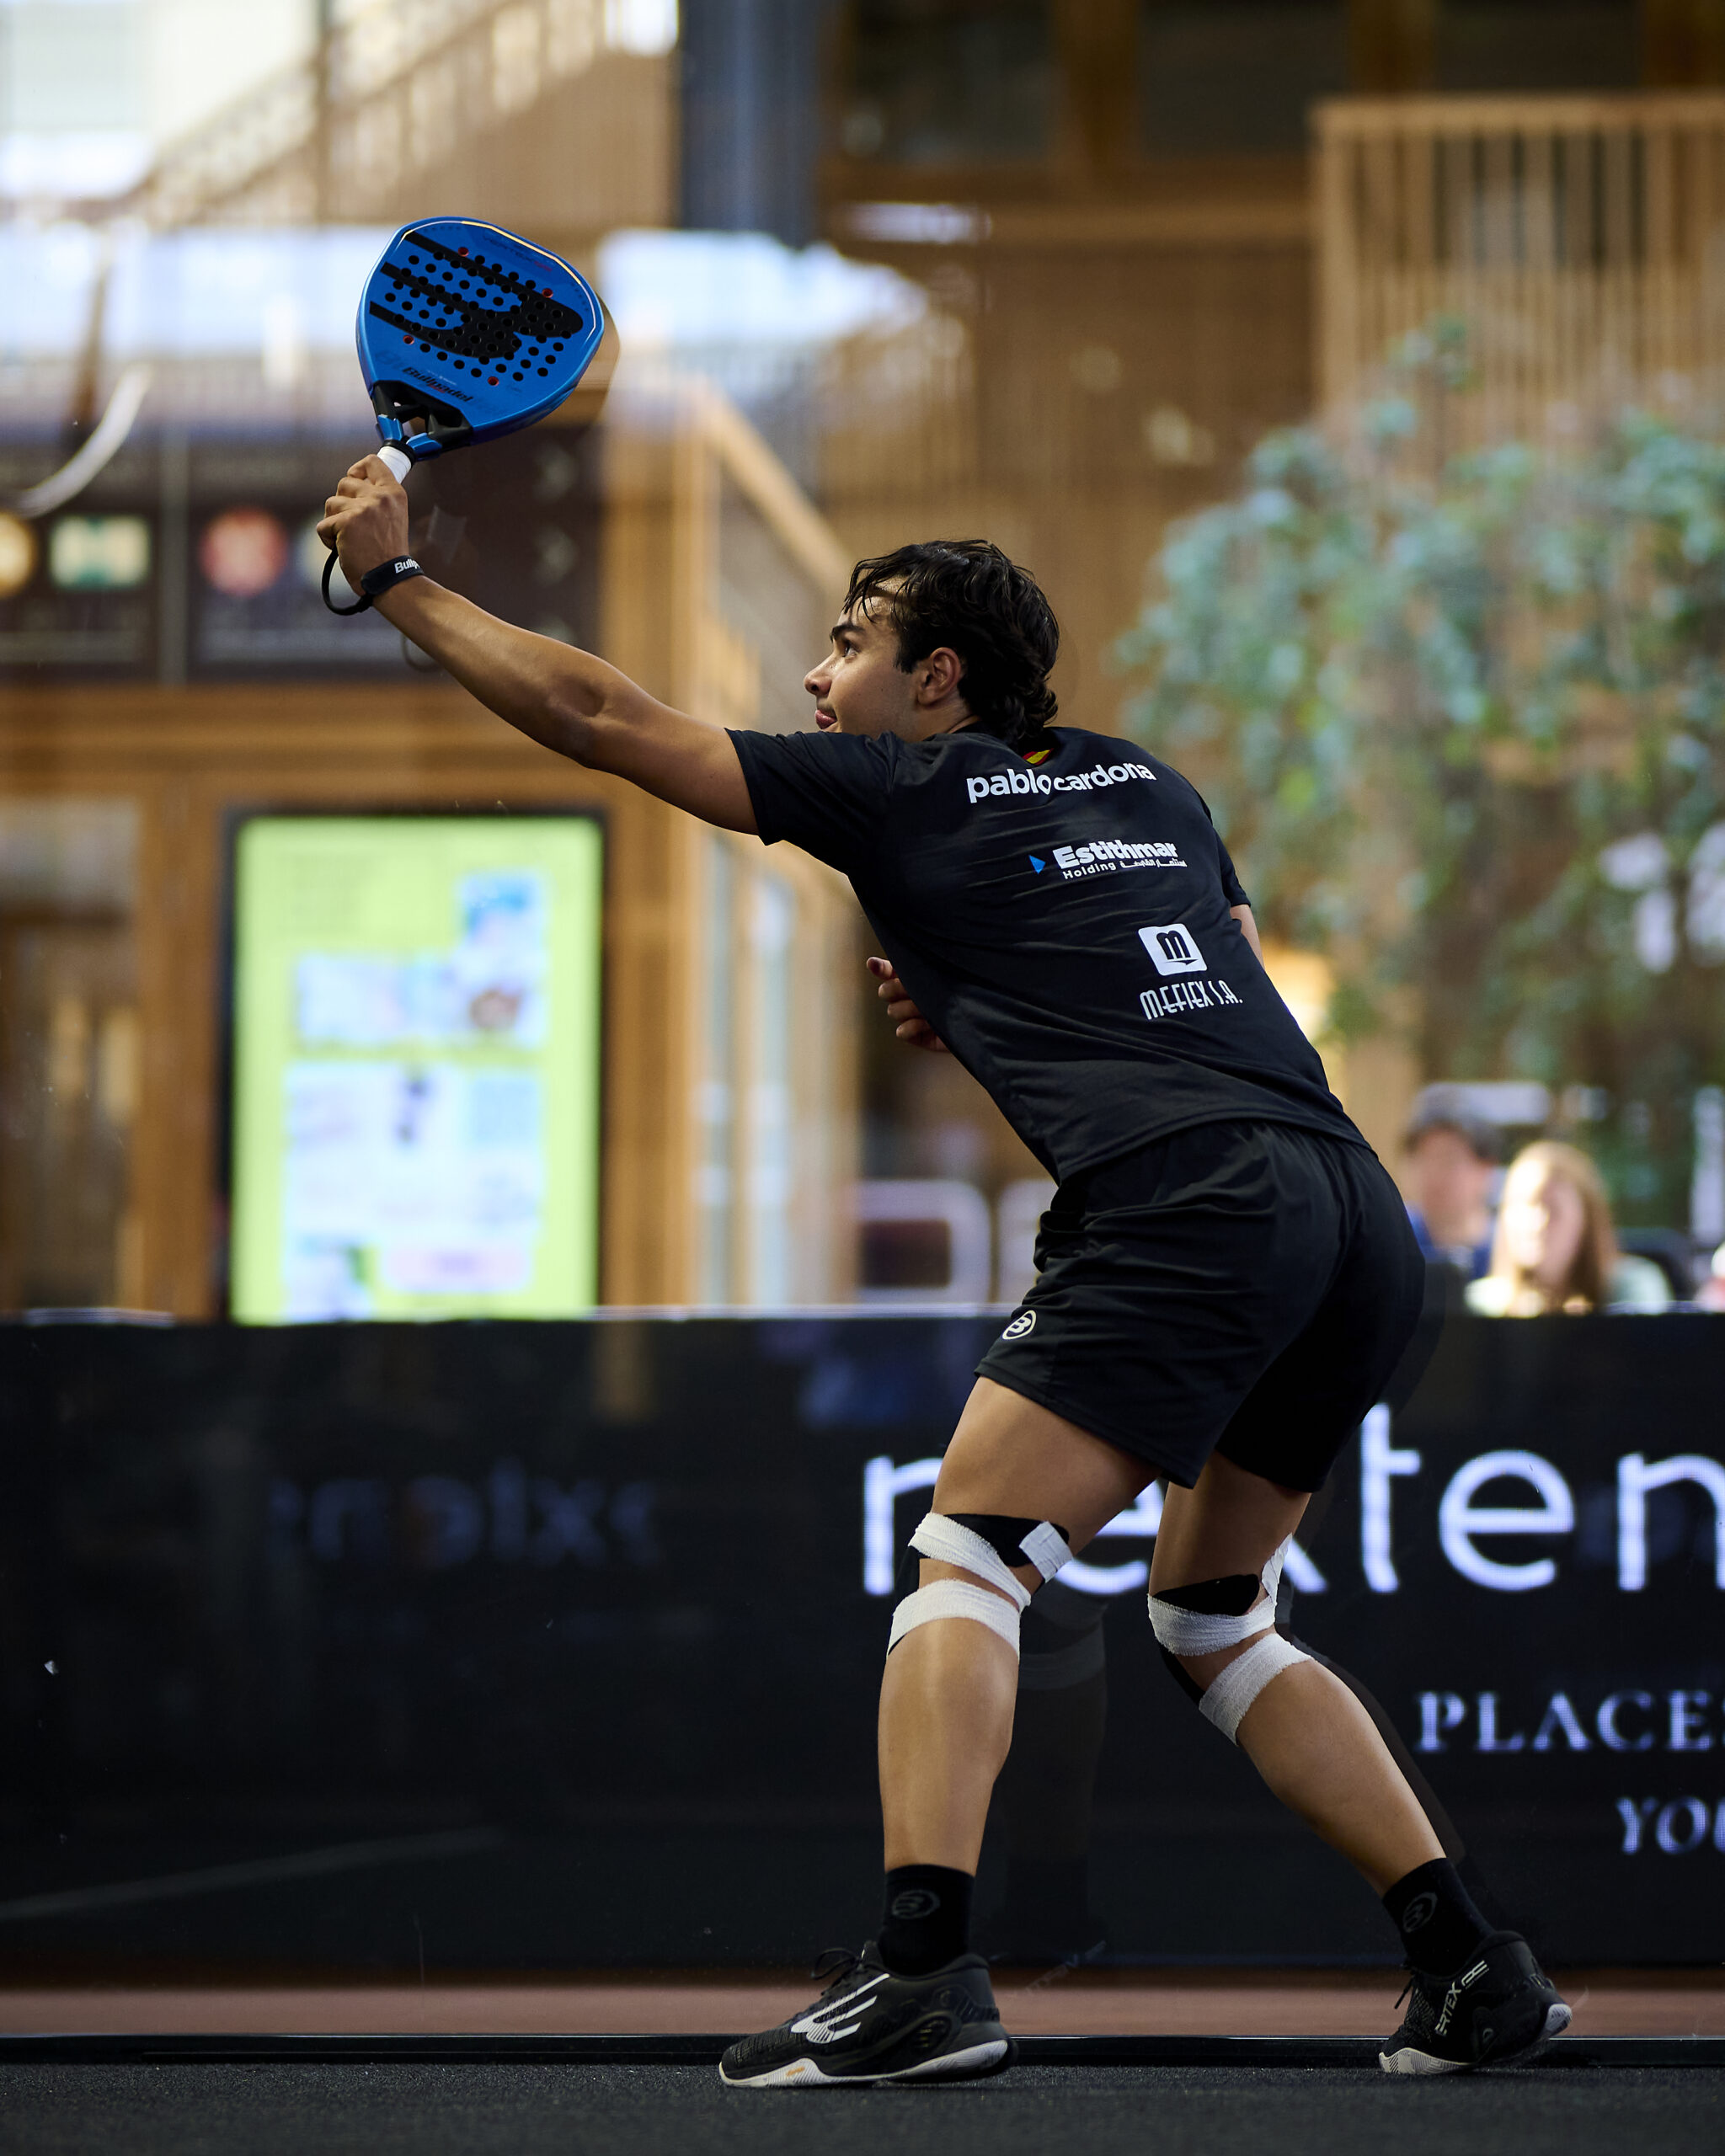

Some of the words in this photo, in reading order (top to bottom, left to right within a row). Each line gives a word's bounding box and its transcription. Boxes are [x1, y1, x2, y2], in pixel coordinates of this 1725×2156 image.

[1053, 840, 1178, 869] Estithmar
[1063, 861, 1117, 879] Holding
[1414, 1689, 1725, 1753] PLACE
[1616, 1795, 1725, 1855] YO
